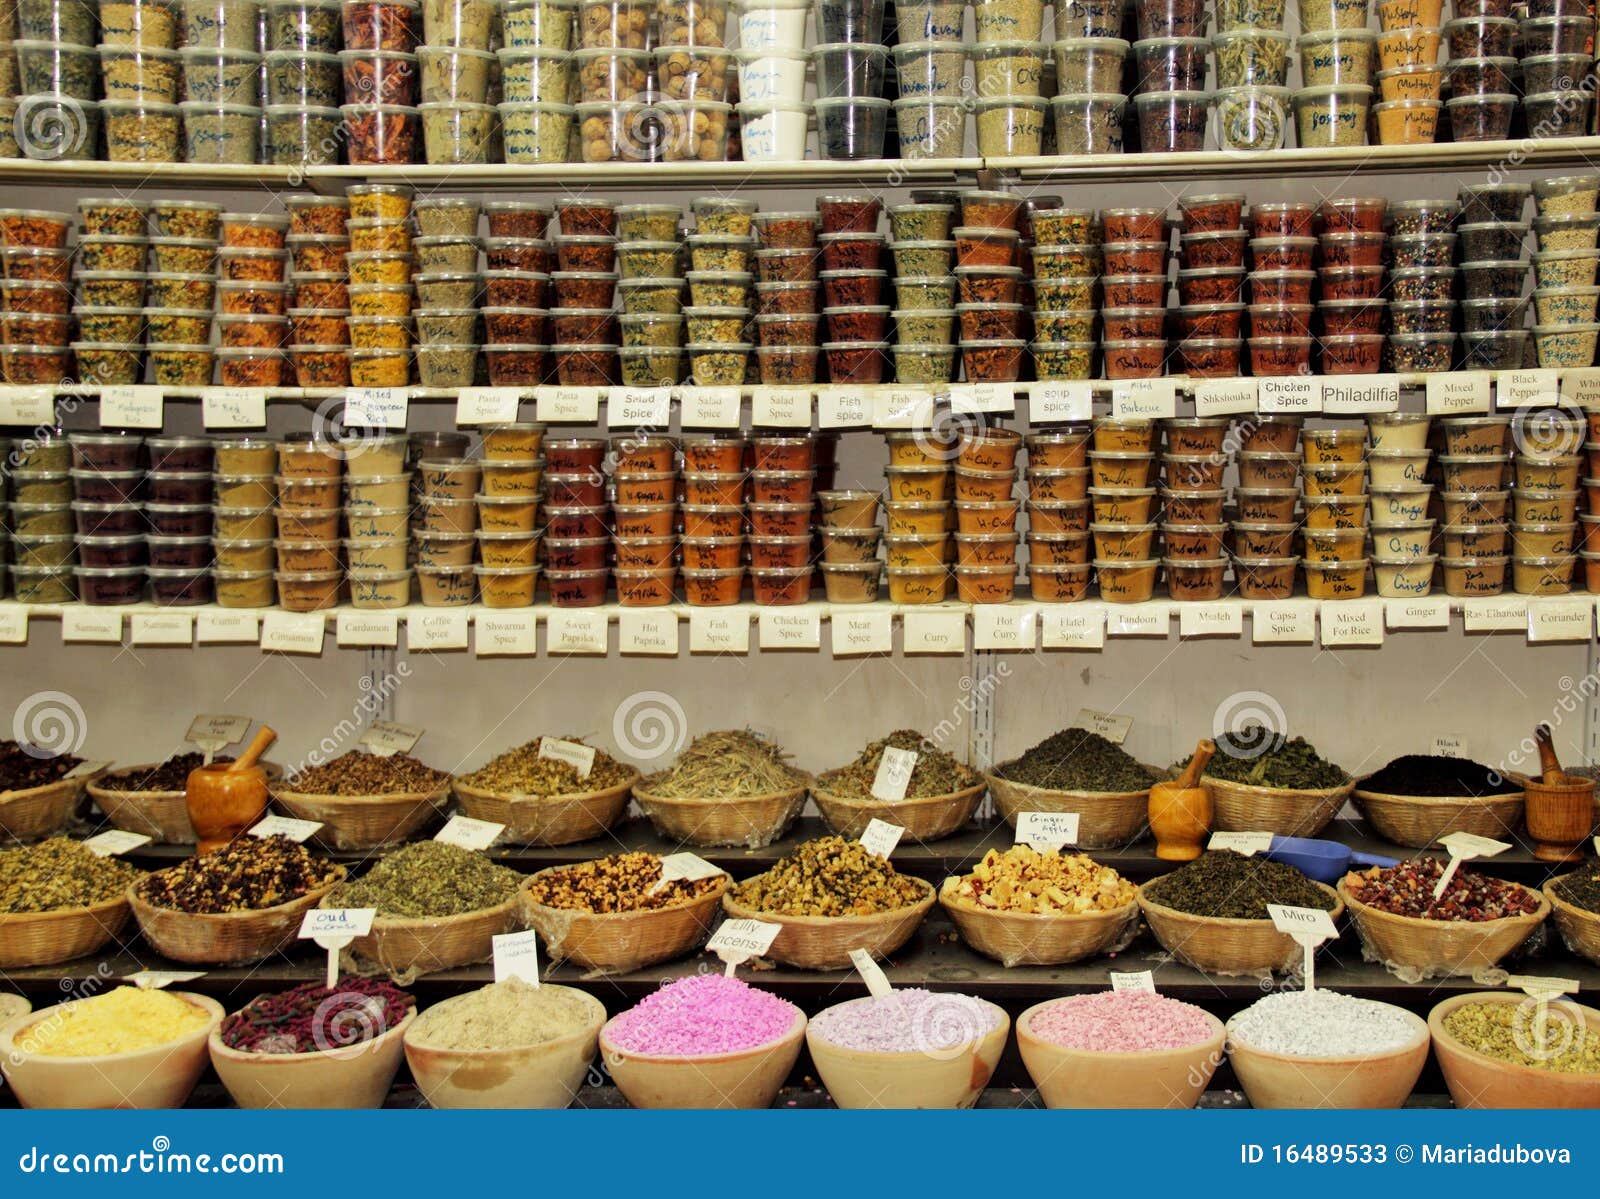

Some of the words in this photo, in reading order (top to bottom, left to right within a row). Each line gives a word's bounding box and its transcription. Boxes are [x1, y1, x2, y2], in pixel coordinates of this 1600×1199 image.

[1512, 375, 1537, 384] Black
[1265, 383, 1310, 392] Chicken
[1444, 383, 1473, 393] Mixed
[1324, 387, 1398, 402] Philadilfia
[1509, 388, 1540, 399] Pepper
[839, 397, 861, 406] Fish
[1277, 396, 1308, 406] Spice
[1444, 397, 1474, 407] Pepper
[1044, 402, 1070, 412] spice
[623, 408, 653, 419] Spice
[1270, 612, 1297, 623] Capsa
[1336, 613, 1366, 622] Mixed
[1406, 607, 1436, 618] Ginger
[773, 616, 809, 625] Chicken
[996, 617, 1012, 626] Hot
[1119, 614, 1158, 625] Tandoori
[1540, 613, 1586, 623] Coriander
[642, 623, 658, 632] Hot
[709, 619, 728, 629] Fish
[1271, 624, 1296, 634] Spice
[779, 629, 803, 640] Spice
[993, 629, 1017, 641] Curry
[1333, 627, 1347, 637] For
[1350, 625, 1371, 635] Rice
[633, 636, 665, 647] Paprika
[706, 633, 730, 643] Spice
[924, 632, 949, 643] Curry
[1437, 739, 1459, 747] Black
[1030, 814, 1064, 826] Ginger
[1282, 909, 1316, 922] Miro
